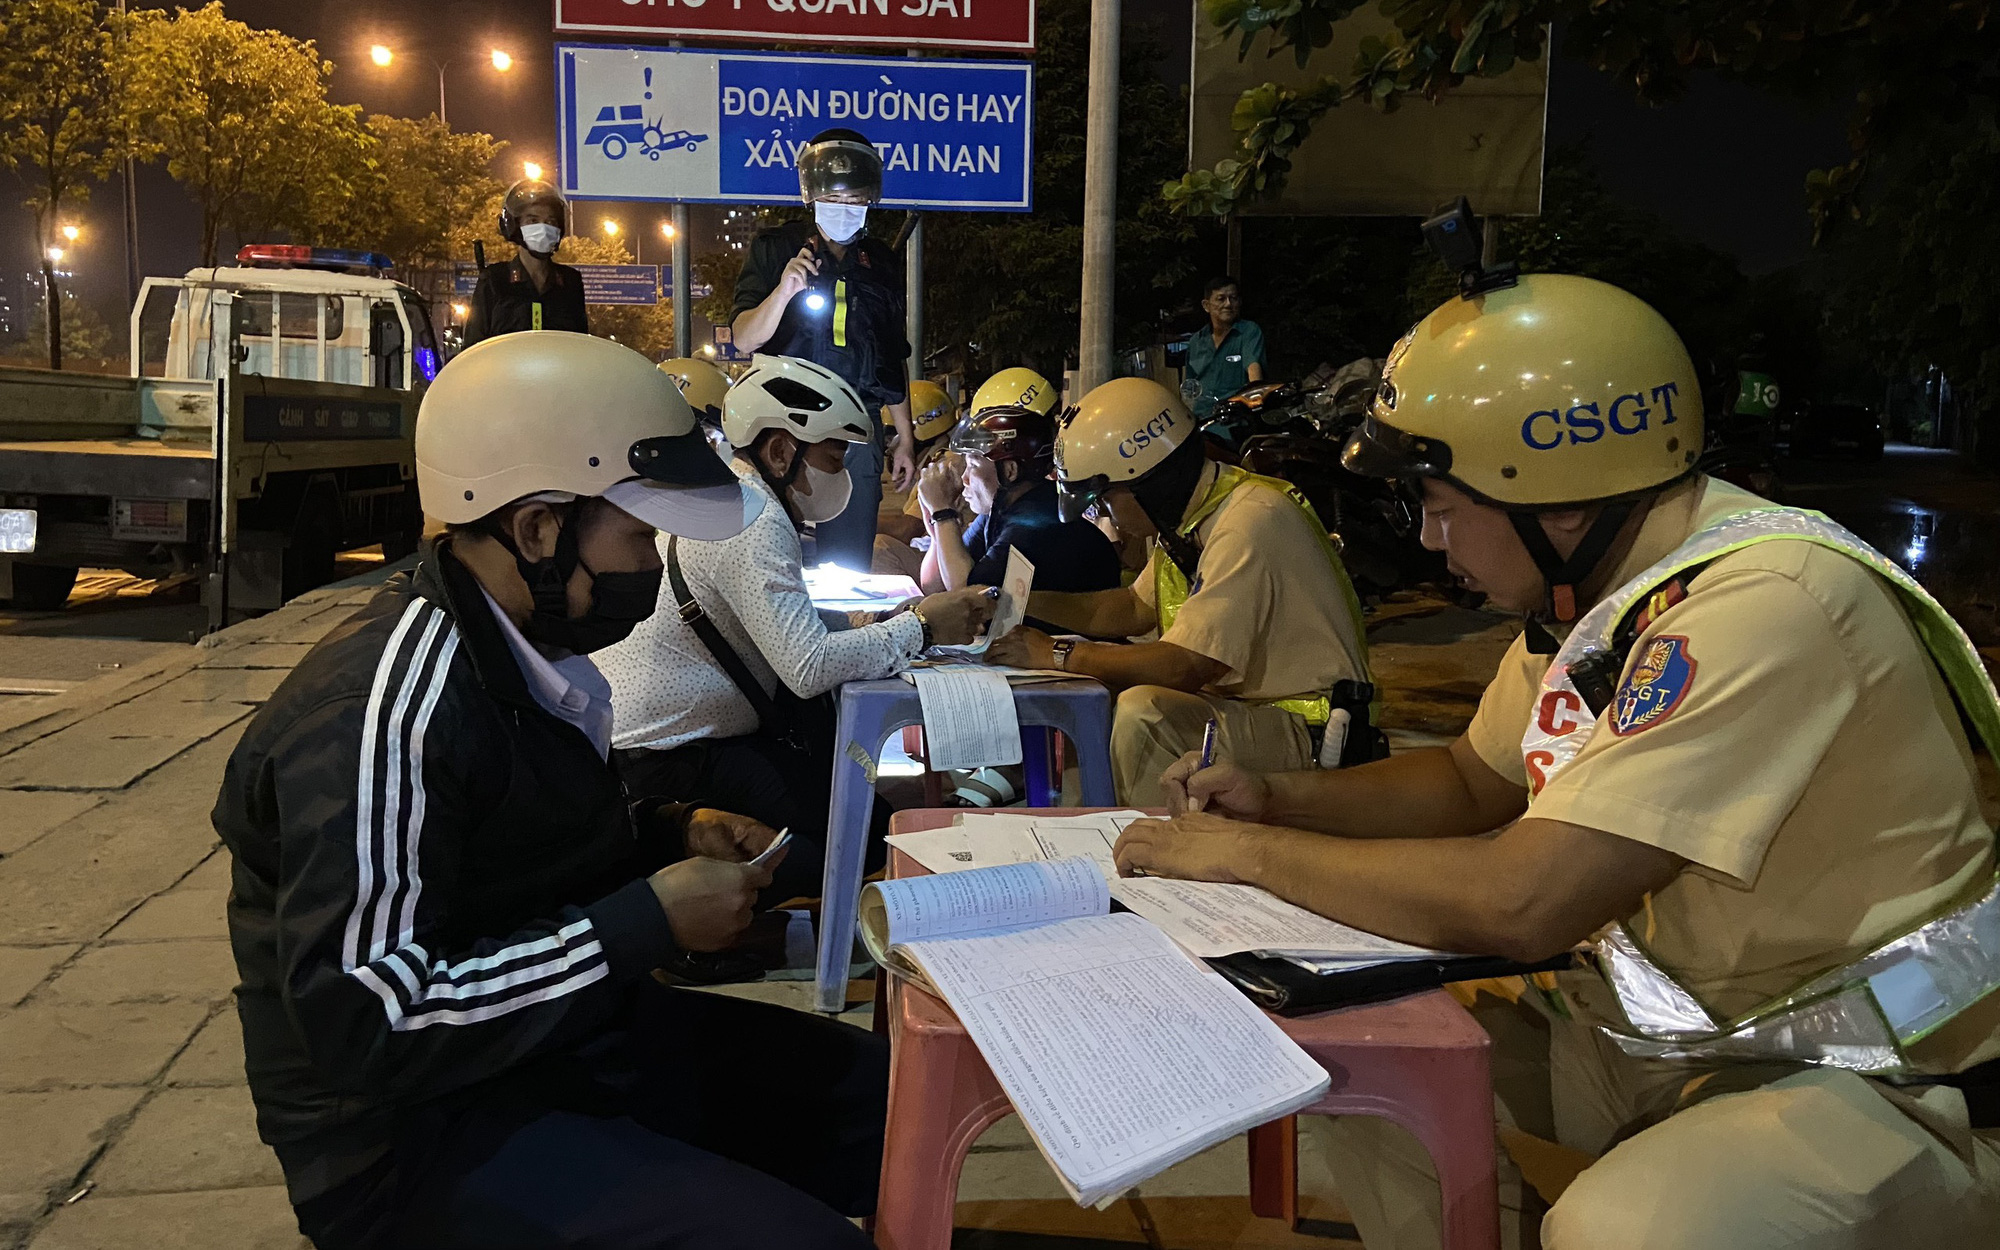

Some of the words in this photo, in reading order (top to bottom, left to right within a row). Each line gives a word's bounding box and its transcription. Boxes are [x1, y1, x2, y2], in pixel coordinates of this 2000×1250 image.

[722, 86, 820, 122] ĐOẠN
[828, 75, 950, 122] ĐƯỜNG
[957, 93, 1022, 123] HAY
[744, 129, 807, 168] XẢY
[872, 142, 919, 172] TAI
[928, 143, 1000, 177] NẠN
[1118, 407, 1176, 459] CSGT
[1521, 381, 1680, 451] CSGT
